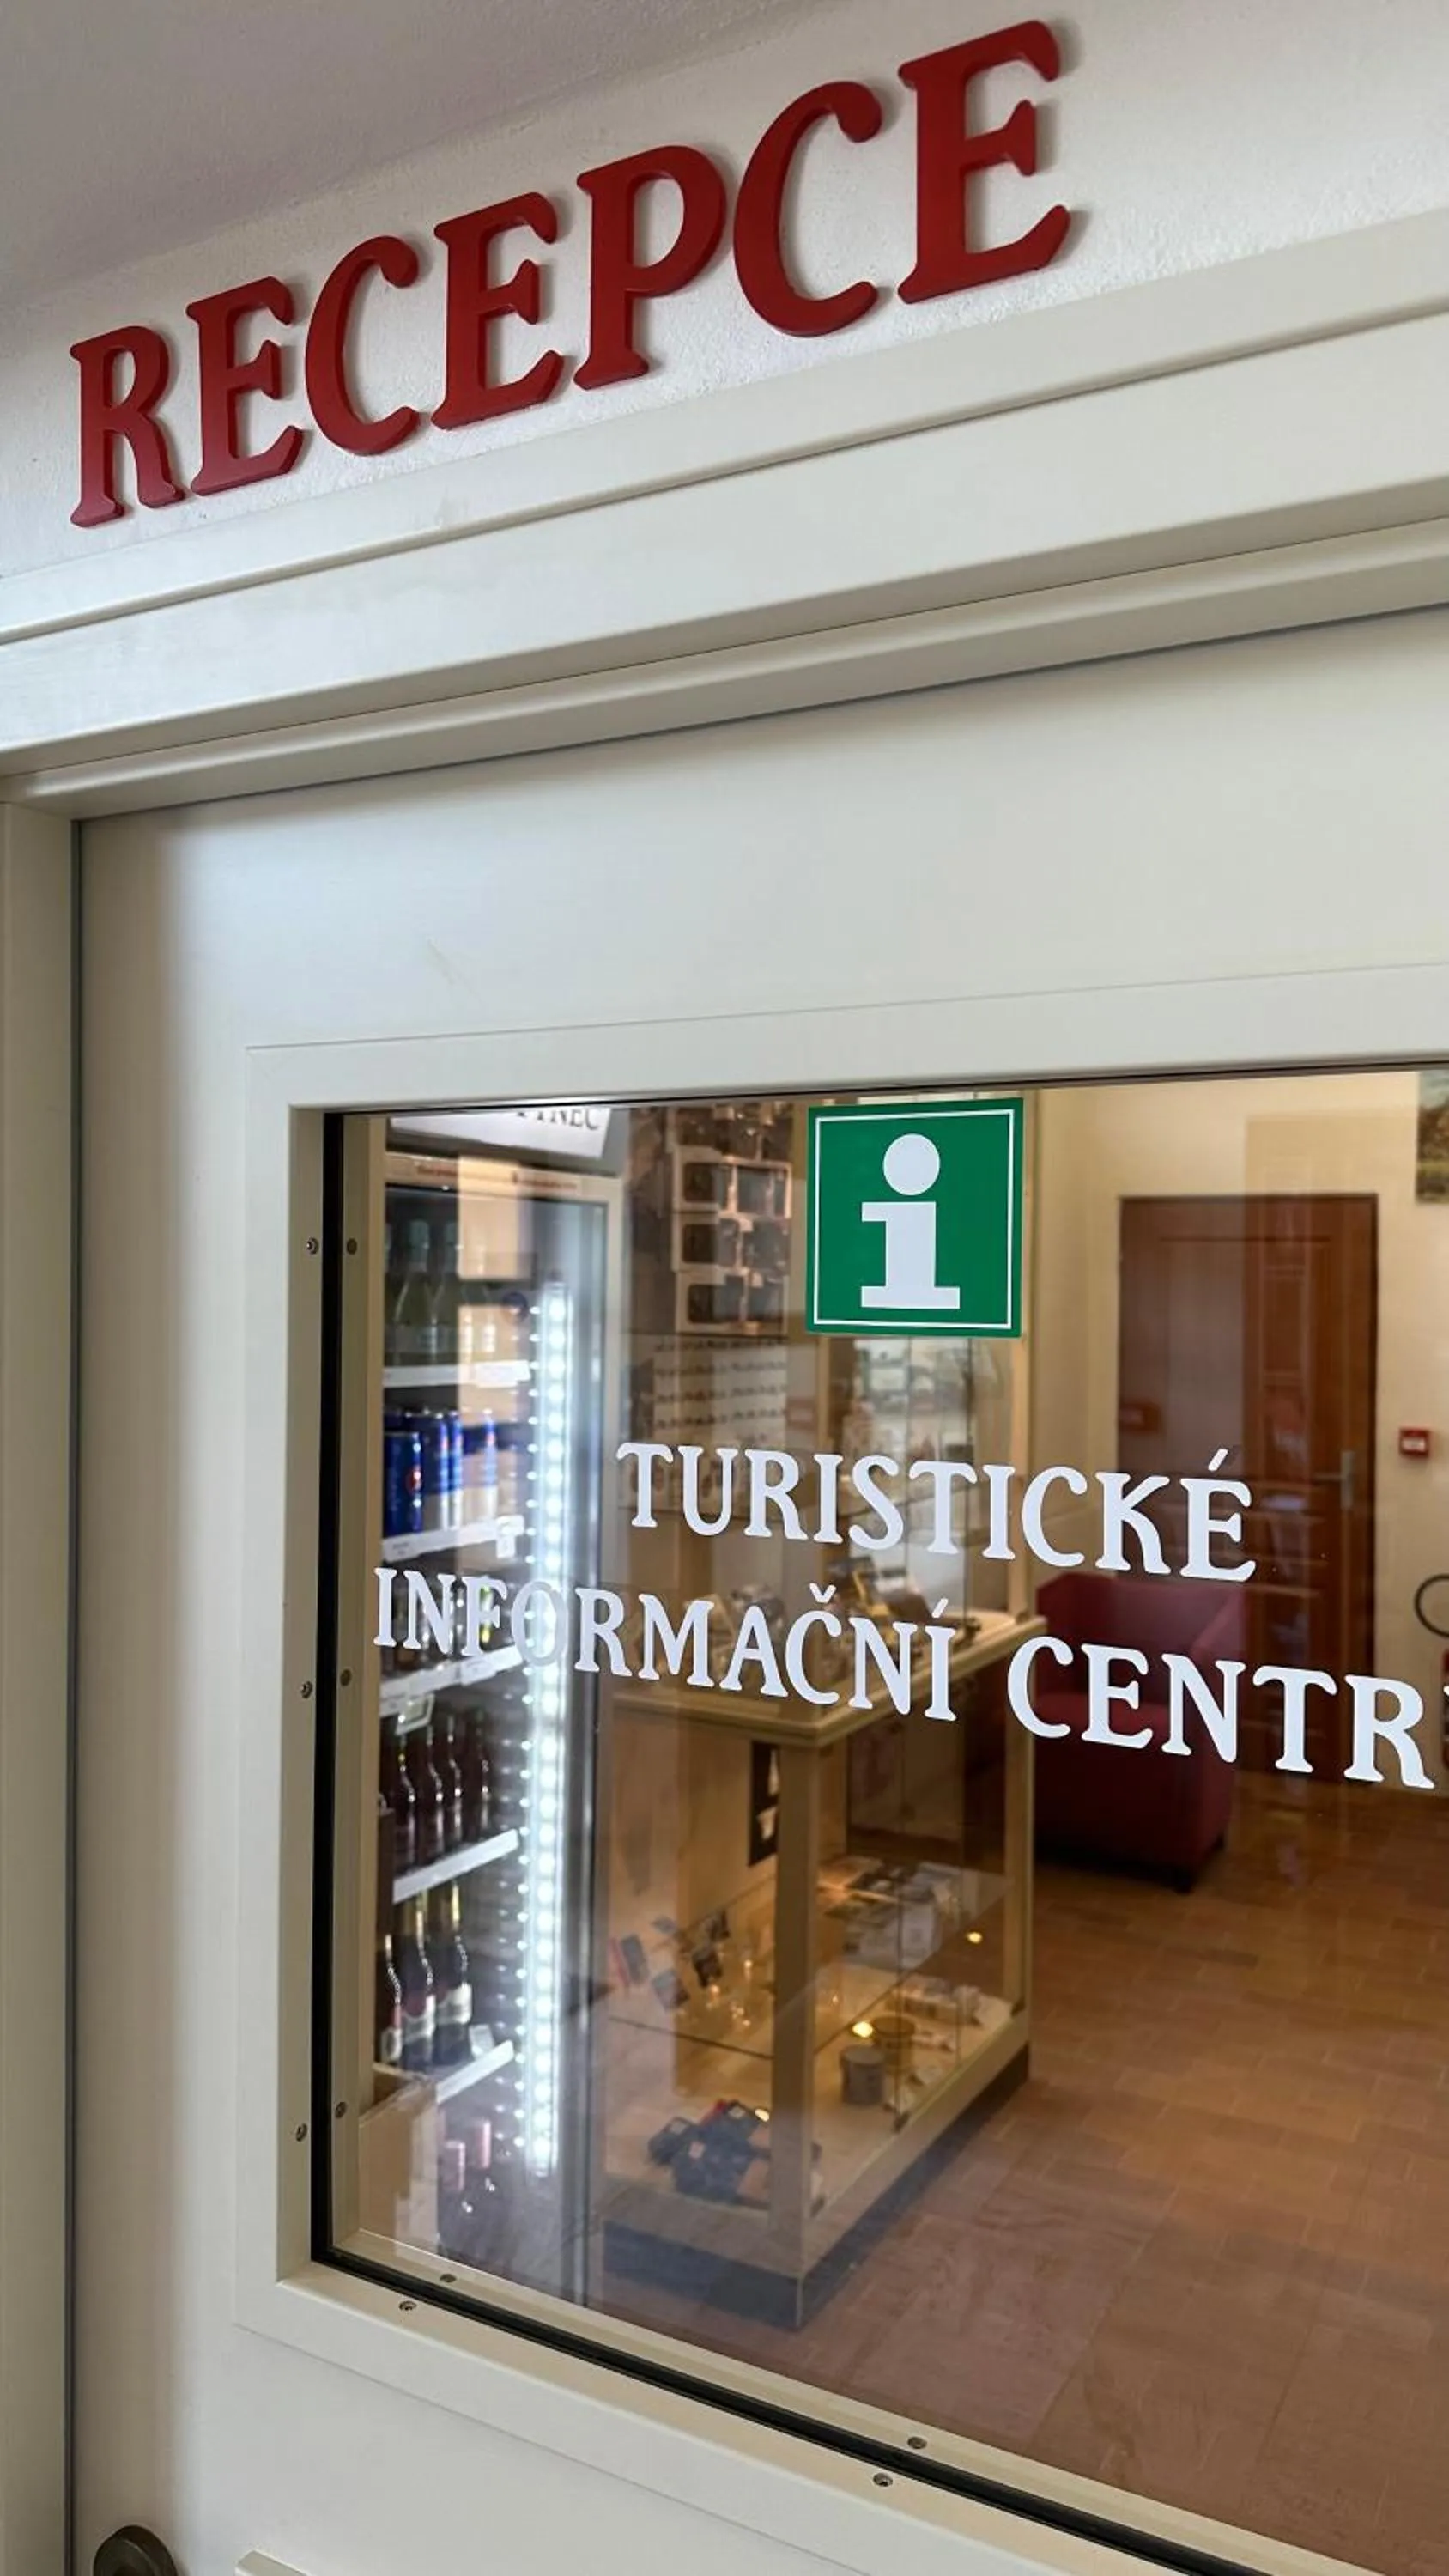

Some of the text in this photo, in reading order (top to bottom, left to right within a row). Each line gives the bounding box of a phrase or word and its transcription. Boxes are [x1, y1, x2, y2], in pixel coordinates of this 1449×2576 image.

[70, 20, 1071, 528] RECEPCE
[616, 1442, 1257, 1583] TURISTICKÉ
[373, 1567, 1449, 1789] INFORMAČNÍ CENTR
